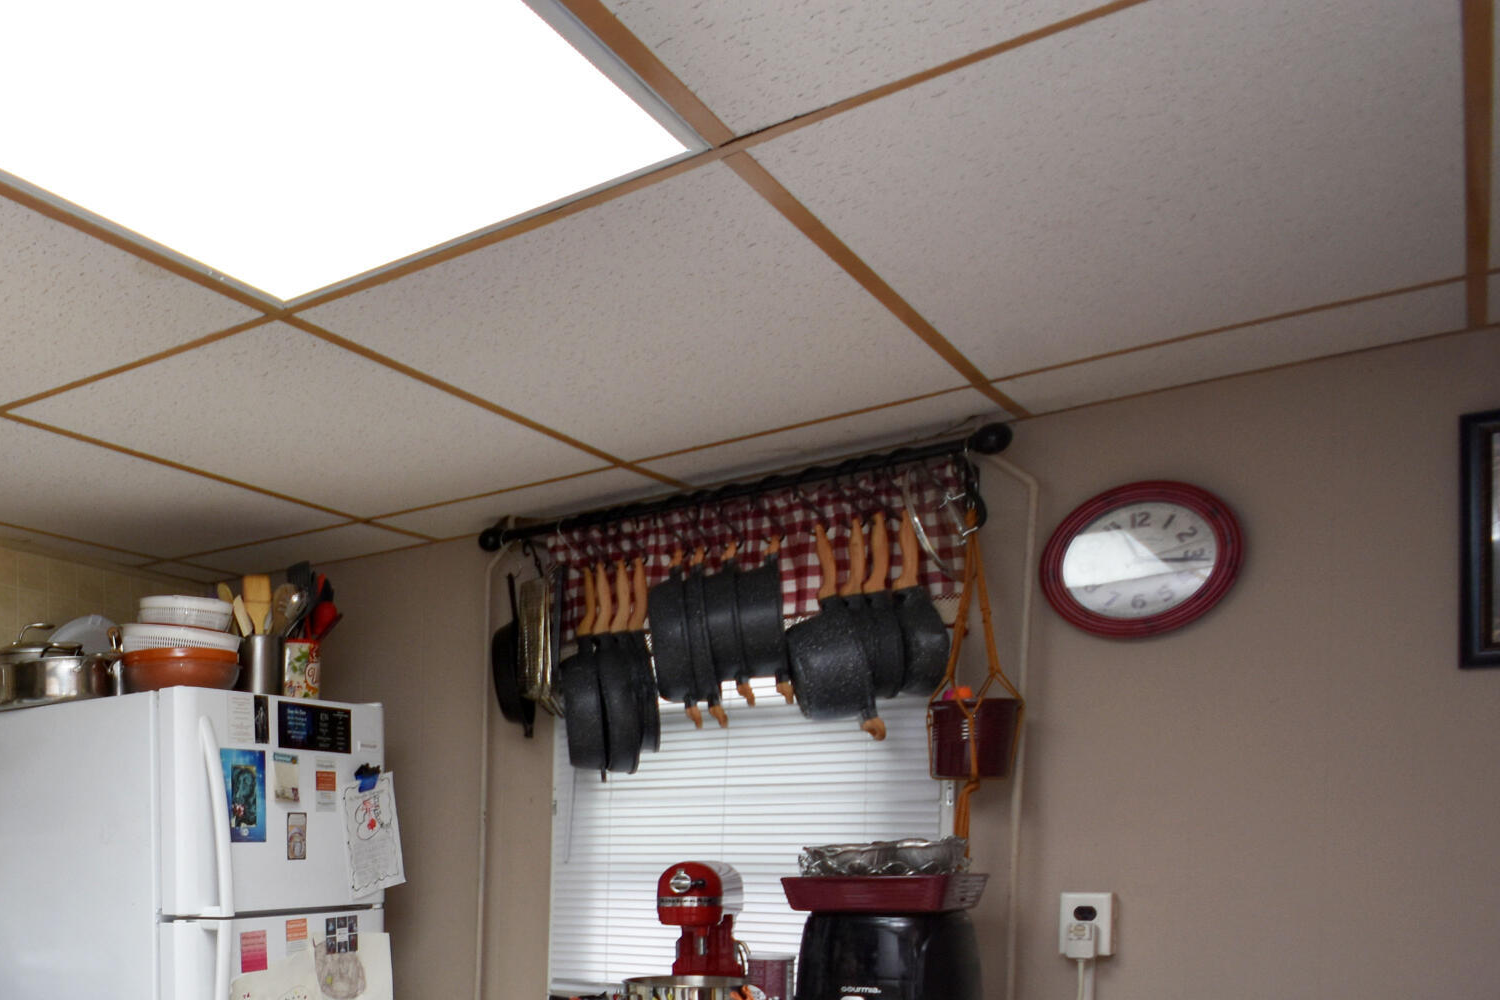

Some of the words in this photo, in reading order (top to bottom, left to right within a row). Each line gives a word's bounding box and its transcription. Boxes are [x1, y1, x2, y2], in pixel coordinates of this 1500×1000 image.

[1130, 512, 1151, 529] 12
[1162, 514, 1176, 530] 1
[1177, 525, 1198, 542] 2
[1130, 593, 1147, 609] 6
